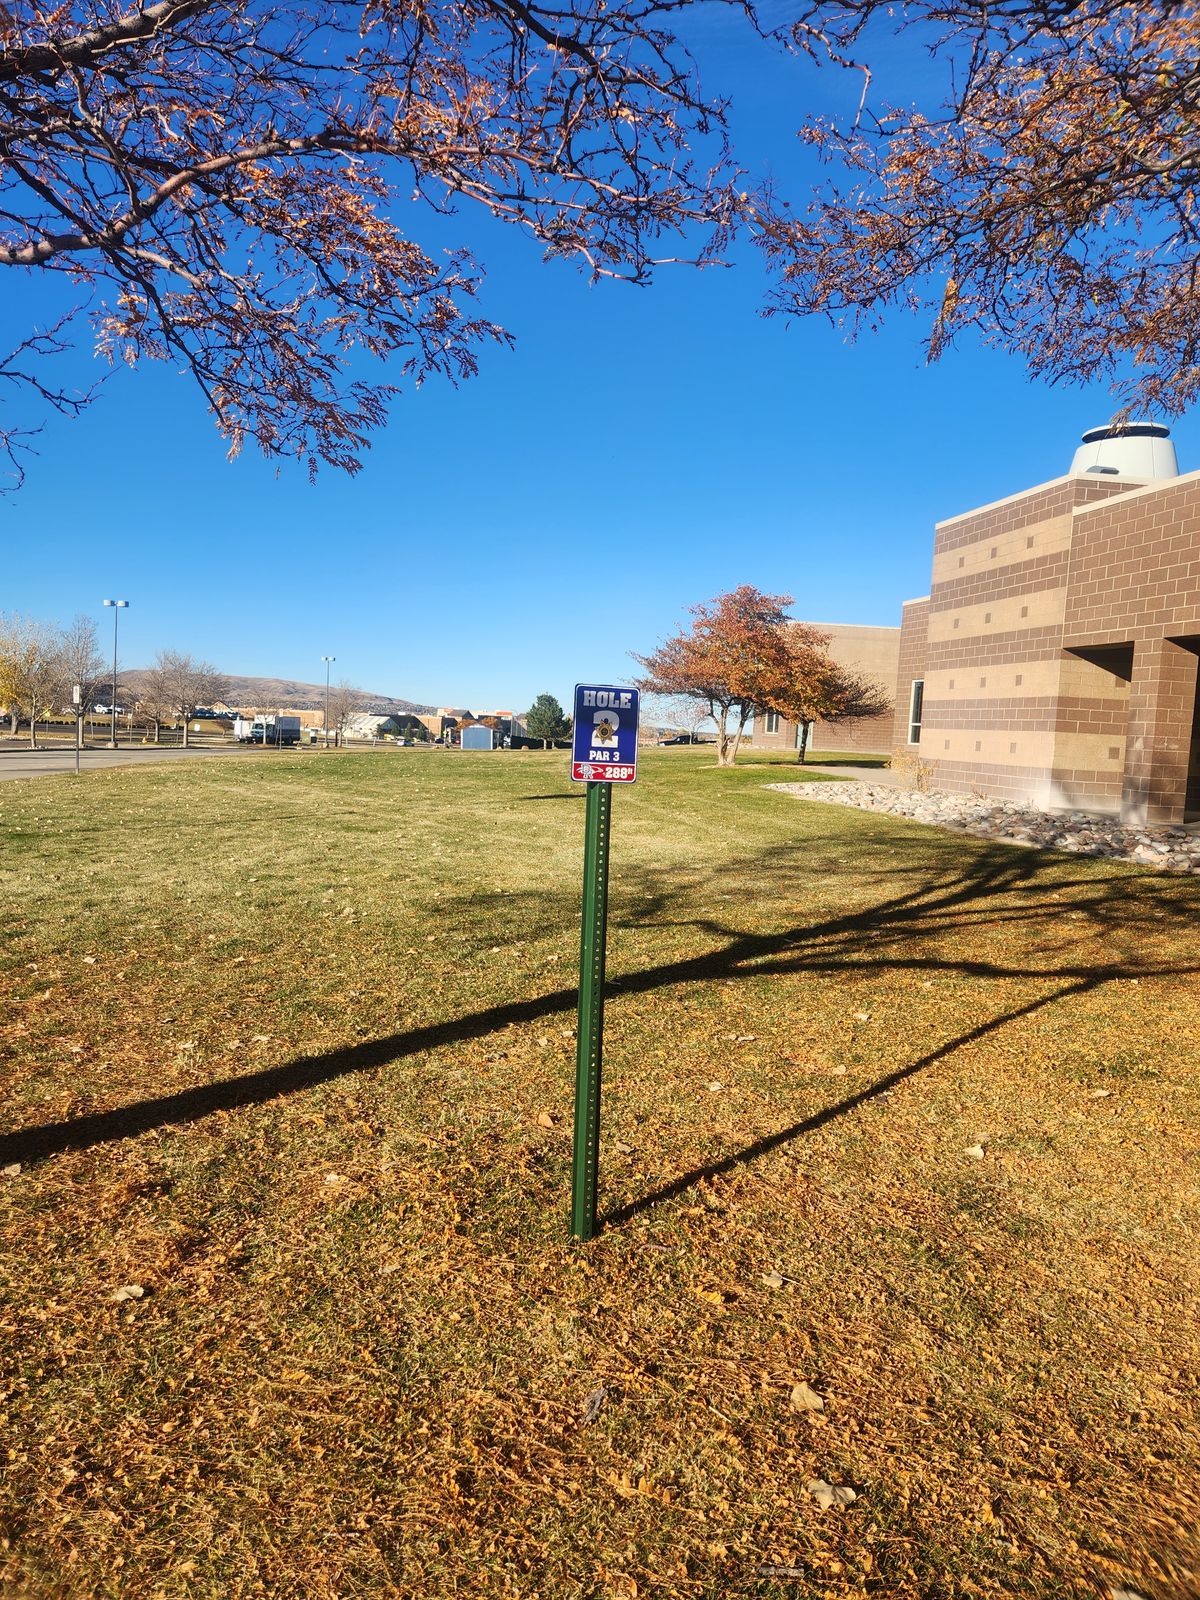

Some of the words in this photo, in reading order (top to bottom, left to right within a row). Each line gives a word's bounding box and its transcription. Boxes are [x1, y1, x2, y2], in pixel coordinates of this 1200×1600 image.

[583, 690, 632, 709] HOLE
[591, 710, 620, 748] 2
[589, 750, 610, 761] PAR
[613, 751, 620, 761] 3
